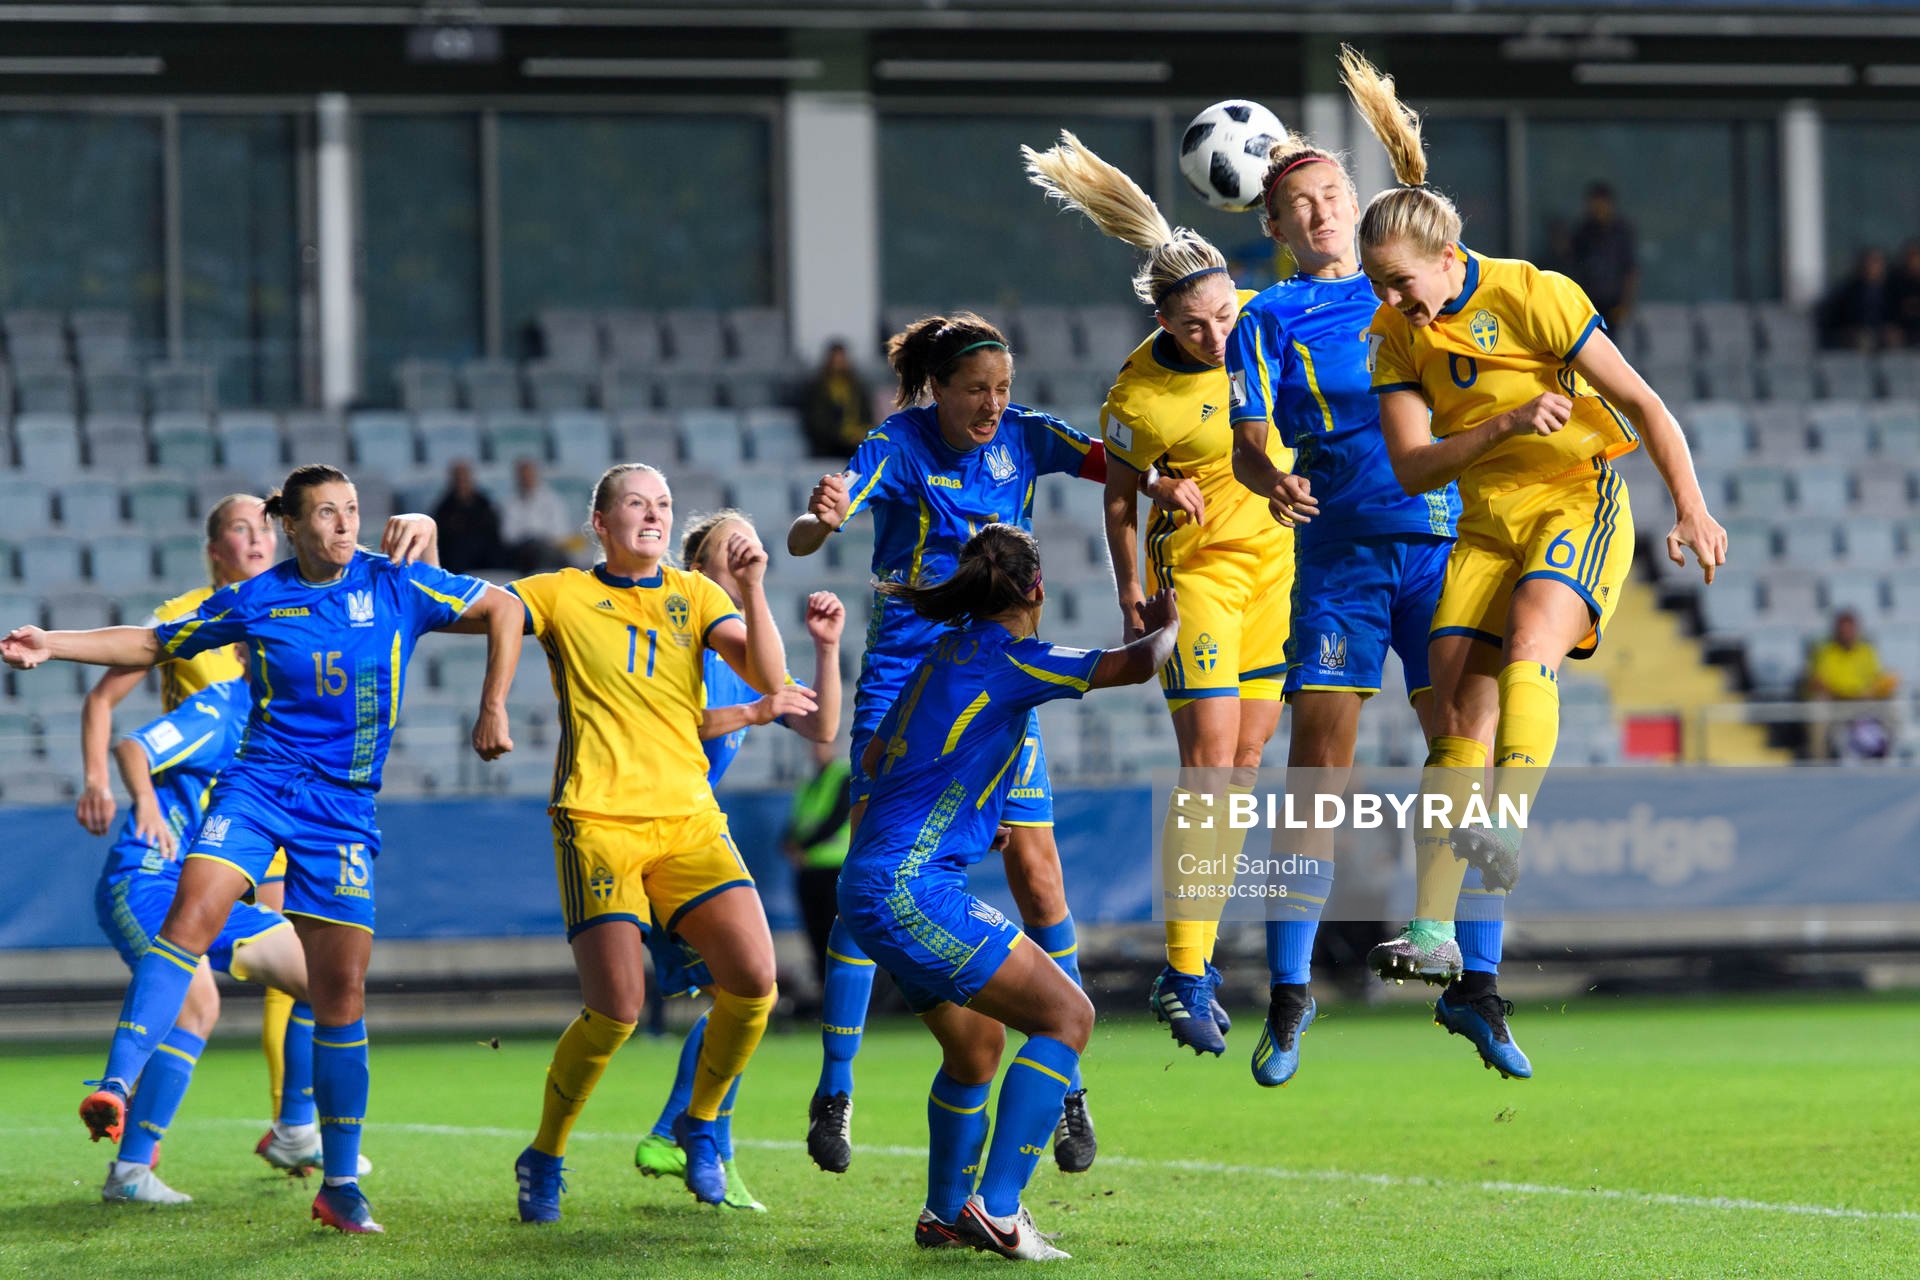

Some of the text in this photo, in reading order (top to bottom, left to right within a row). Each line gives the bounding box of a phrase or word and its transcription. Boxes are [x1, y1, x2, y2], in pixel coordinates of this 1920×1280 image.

[1545, 528, 1576, 569] 6
[312, 651, 348, 697] 15
[626, 625, 657, 677] 11
[336, 844, 368, 886] 15
[1520, 803, 1738, 887] verige
